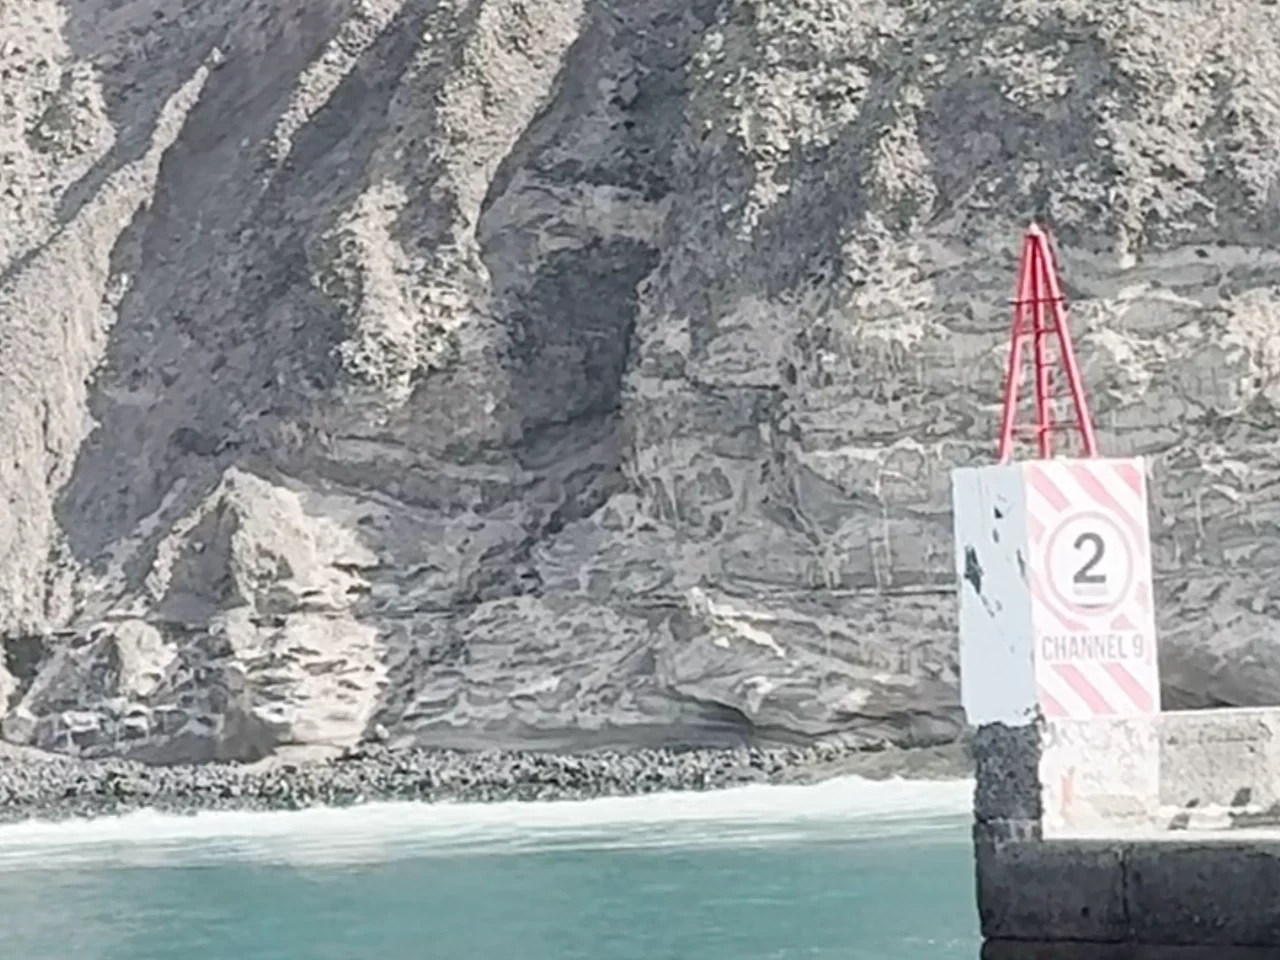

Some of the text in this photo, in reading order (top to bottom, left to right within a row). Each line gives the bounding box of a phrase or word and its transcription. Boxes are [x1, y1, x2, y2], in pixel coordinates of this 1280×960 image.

[1073, 532, 1106, 583] 2
[1041, 633, 1145, 660] CHANNEL 9
